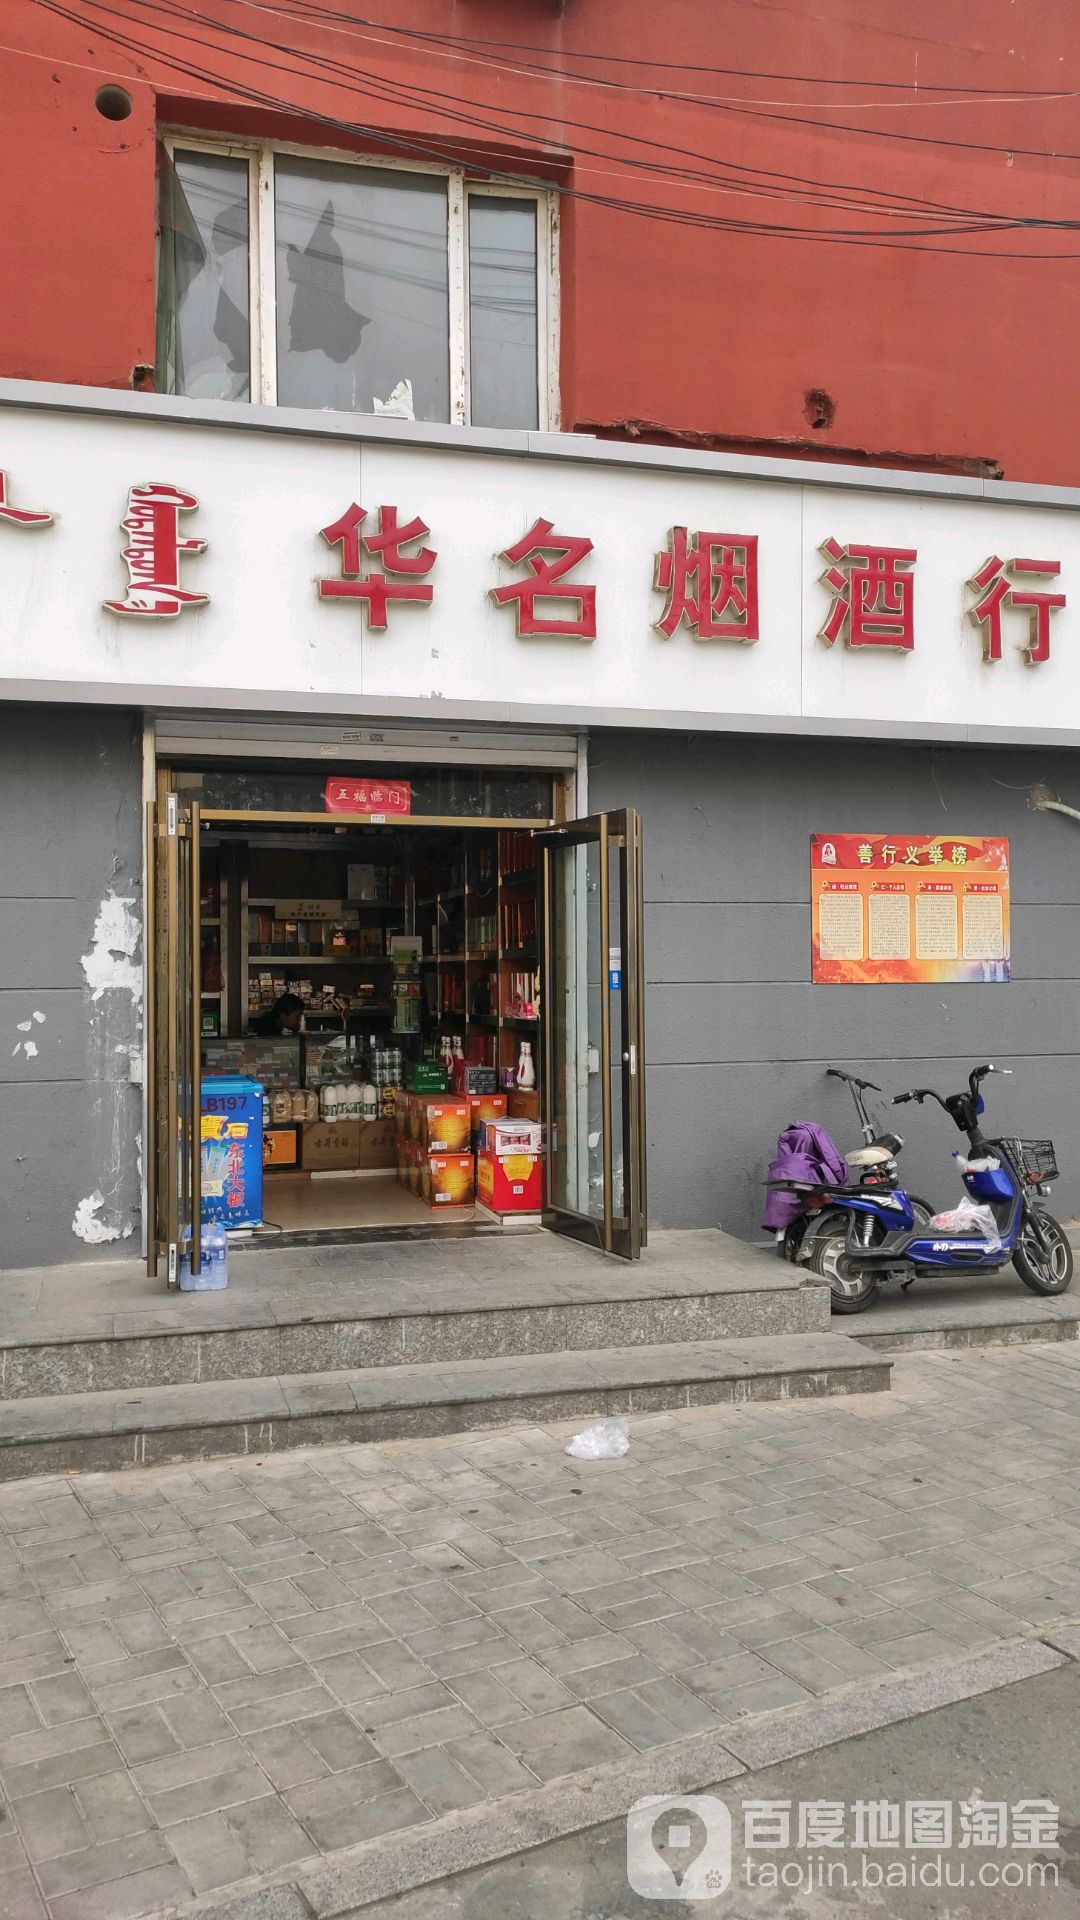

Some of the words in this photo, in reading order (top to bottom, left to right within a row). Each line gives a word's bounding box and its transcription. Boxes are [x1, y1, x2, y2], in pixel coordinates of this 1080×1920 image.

[319, 501, 1067, 667] 华名烟酒行
[336, 788, 401, 805] 五福临门
[858, 844, 967, 865] 善行义举榜
[227, 1142, 245, 1207] 东北大板
